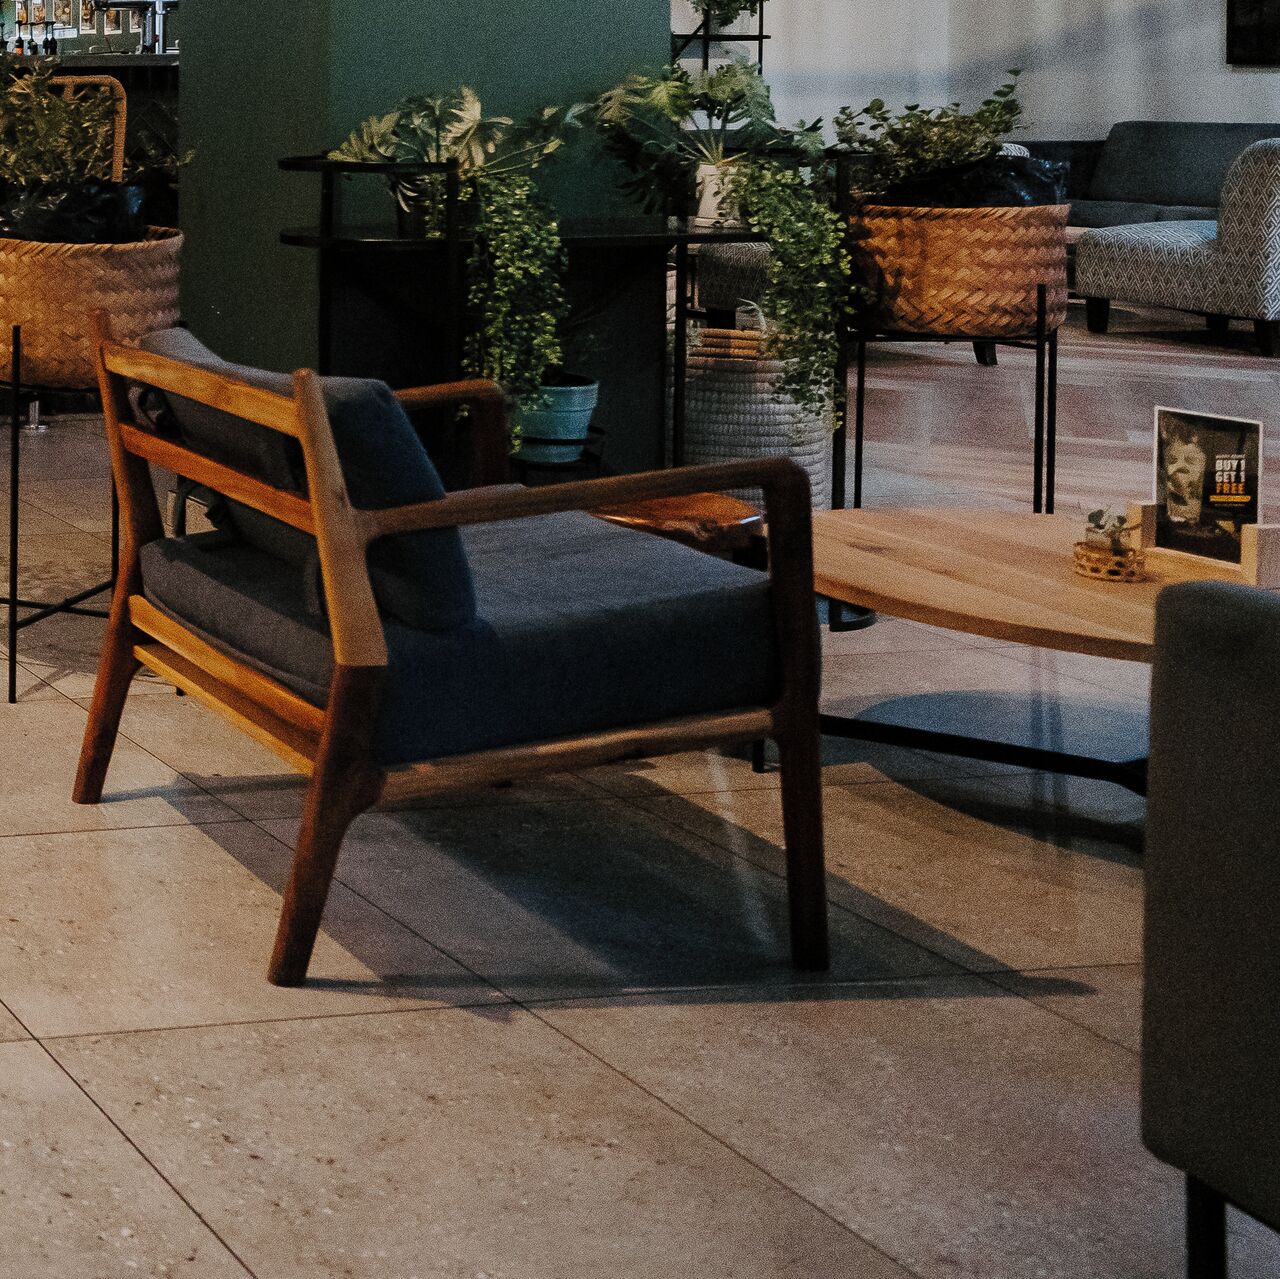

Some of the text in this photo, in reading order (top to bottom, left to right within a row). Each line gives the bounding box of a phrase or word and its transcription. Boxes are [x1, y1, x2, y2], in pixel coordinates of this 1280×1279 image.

[1215, 460, 1238, 470] BUY
[1215, 471, 1236, 482] GET
[1216, 483, 1244, 494] FREE
